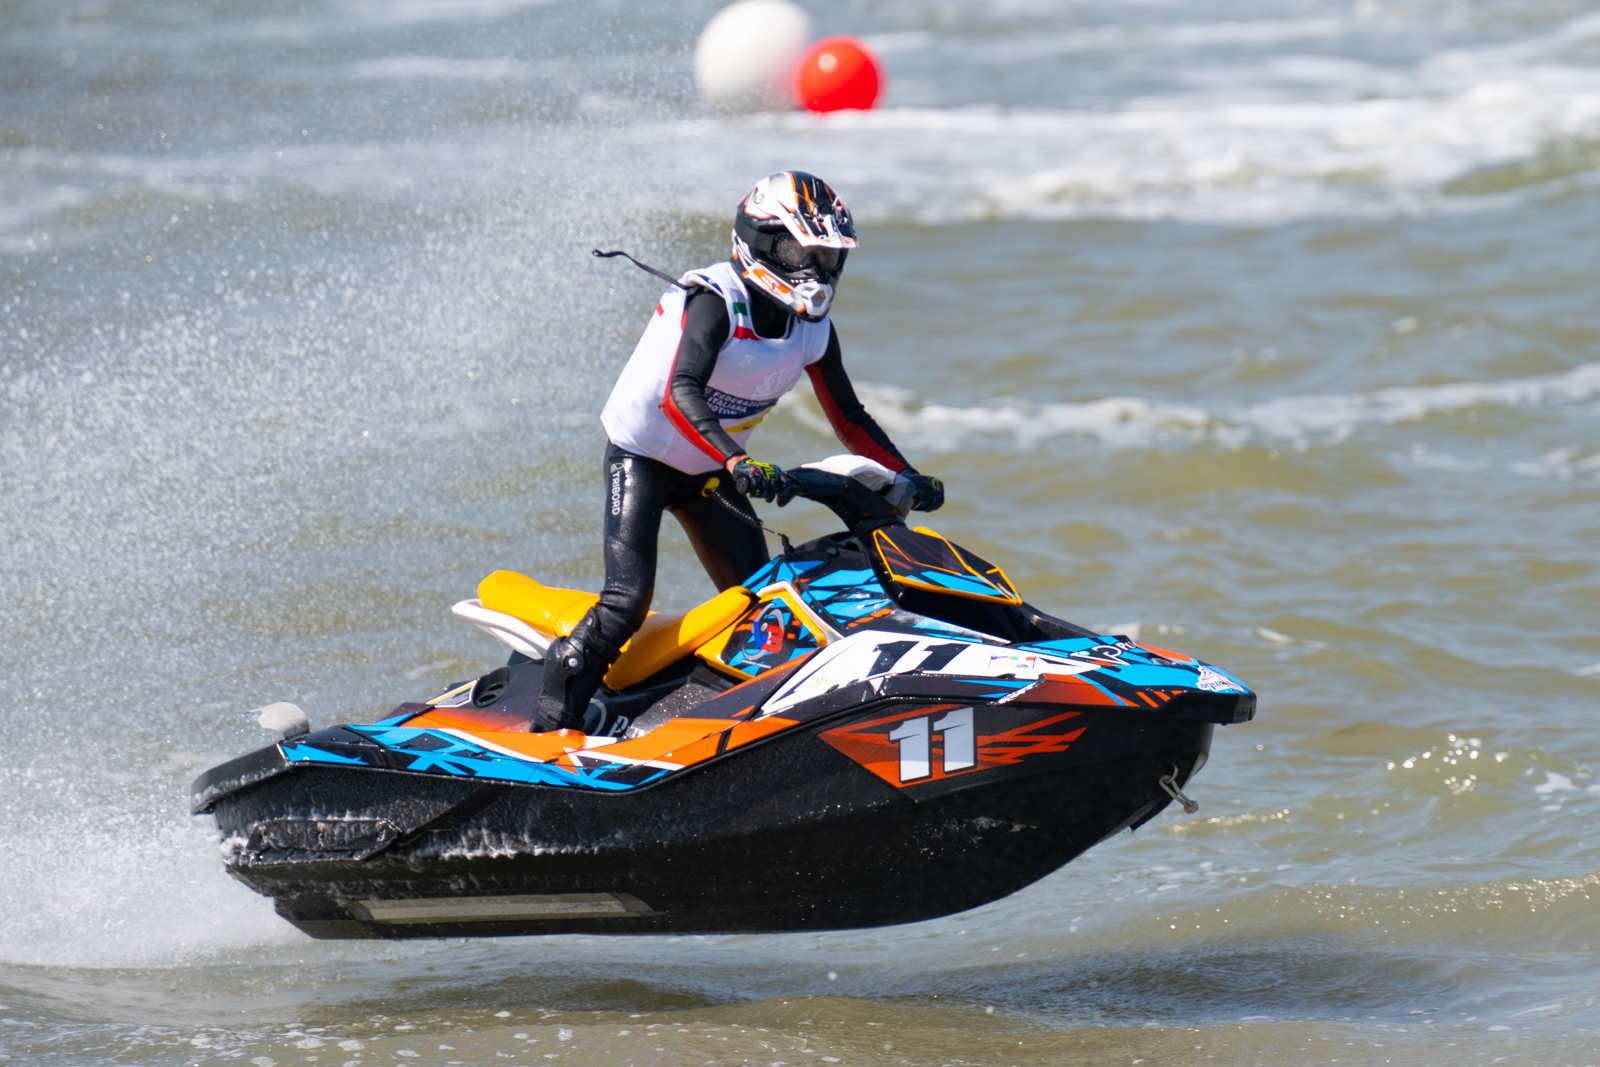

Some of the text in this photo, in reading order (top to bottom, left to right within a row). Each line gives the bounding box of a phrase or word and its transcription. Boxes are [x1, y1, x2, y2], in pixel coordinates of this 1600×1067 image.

[707, 396, 748, 413] ITALIANA
[611, 471, 621, 516] TRIBORD
[866, 640, 973, 678] 11
[889, 707, 975, 782] 11
